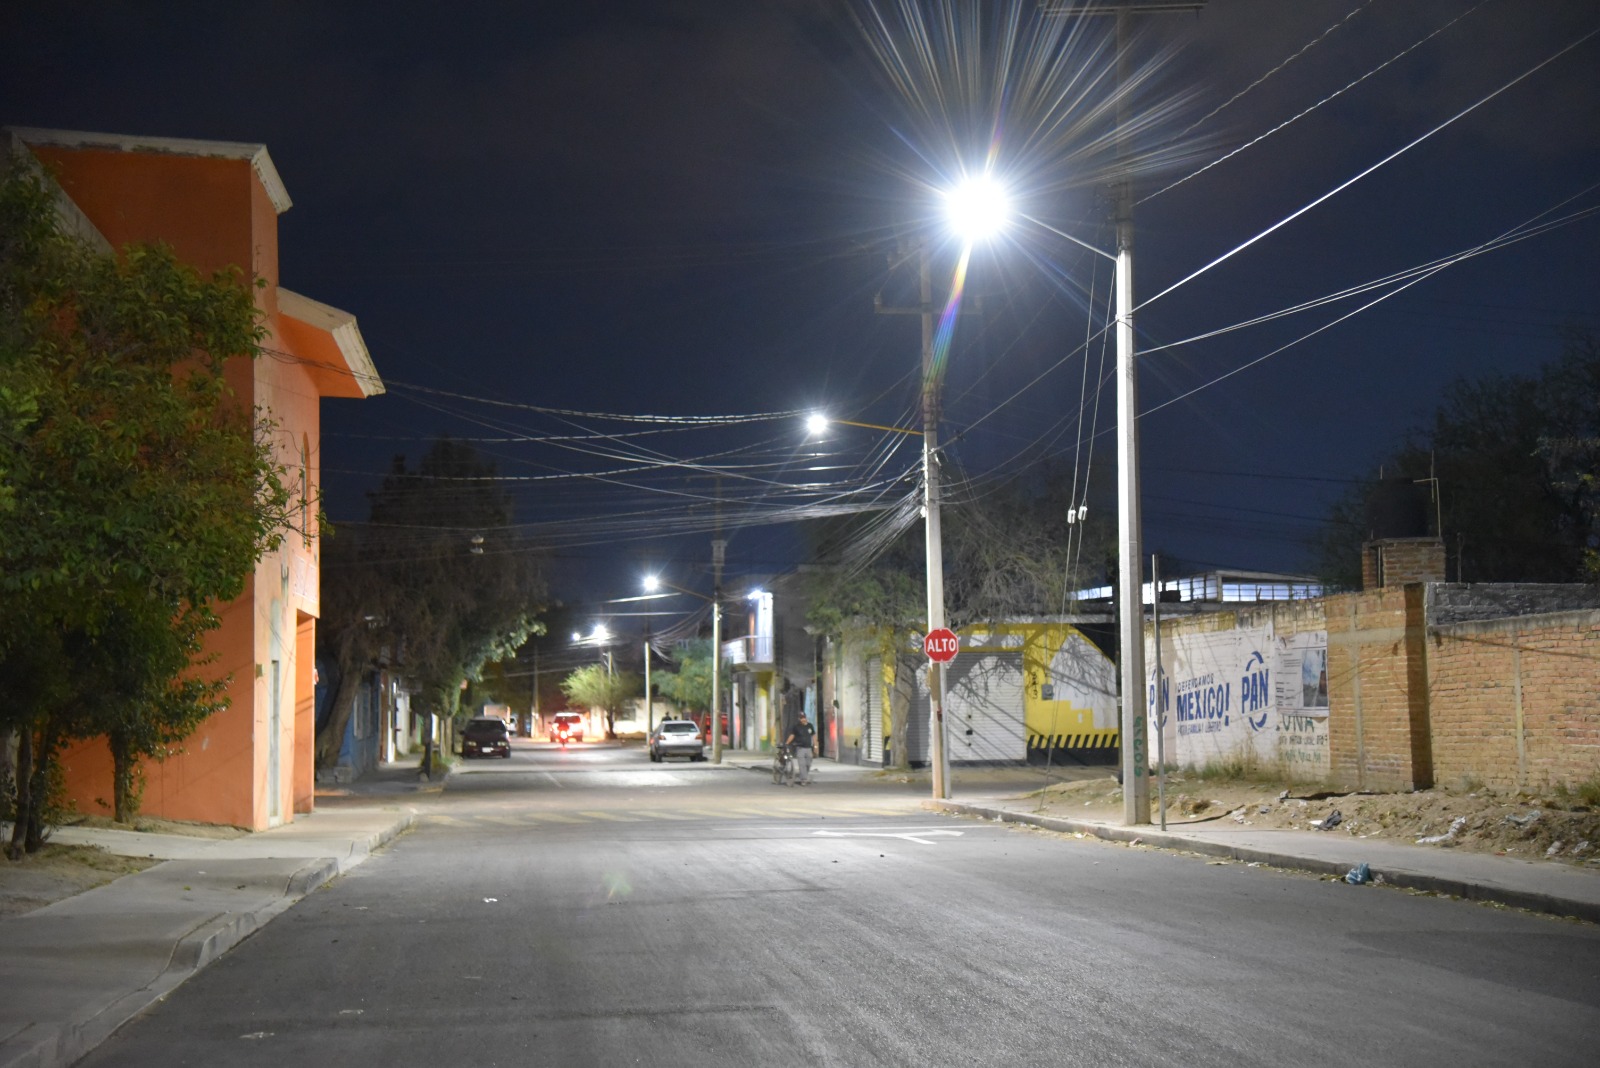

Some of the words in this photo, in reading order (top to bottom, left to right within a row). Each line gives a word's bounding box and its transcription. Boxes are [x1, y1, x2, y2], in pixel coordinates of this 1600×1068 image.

[927, 638, 956, 653] ALTO
[1149, 676, 1169, 718] PN
[1241, 668, 1269, 714] PAN
